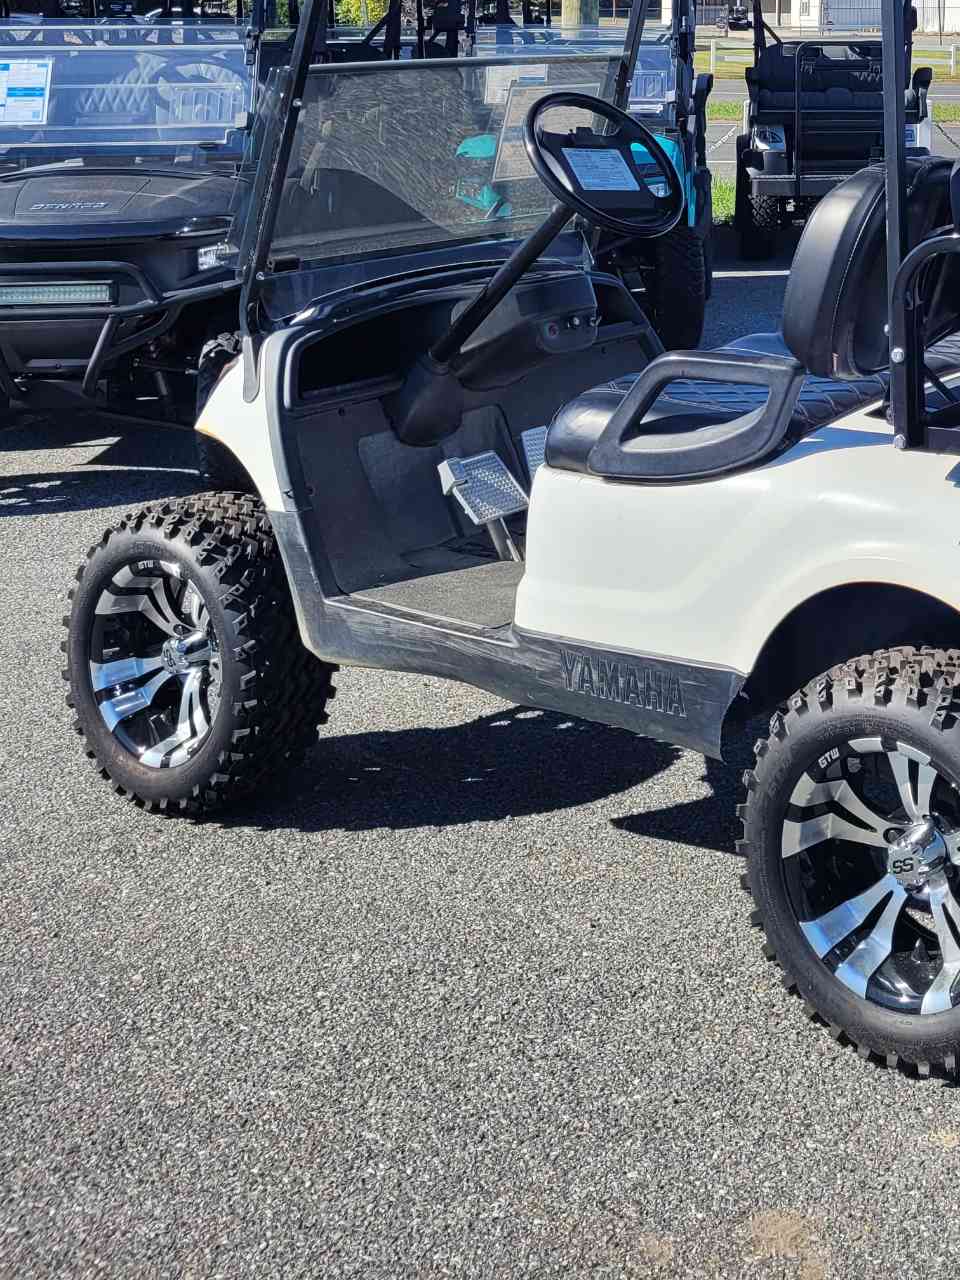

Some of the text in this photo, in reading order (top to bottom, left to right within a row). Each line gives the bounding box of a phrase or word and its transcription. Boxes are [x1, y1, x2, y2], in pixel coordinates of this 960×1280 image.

[559, 646, 688, 718] YAMAHA
[818, 746, 840, 769] GTW
[892, 856, 914, 874] SS
